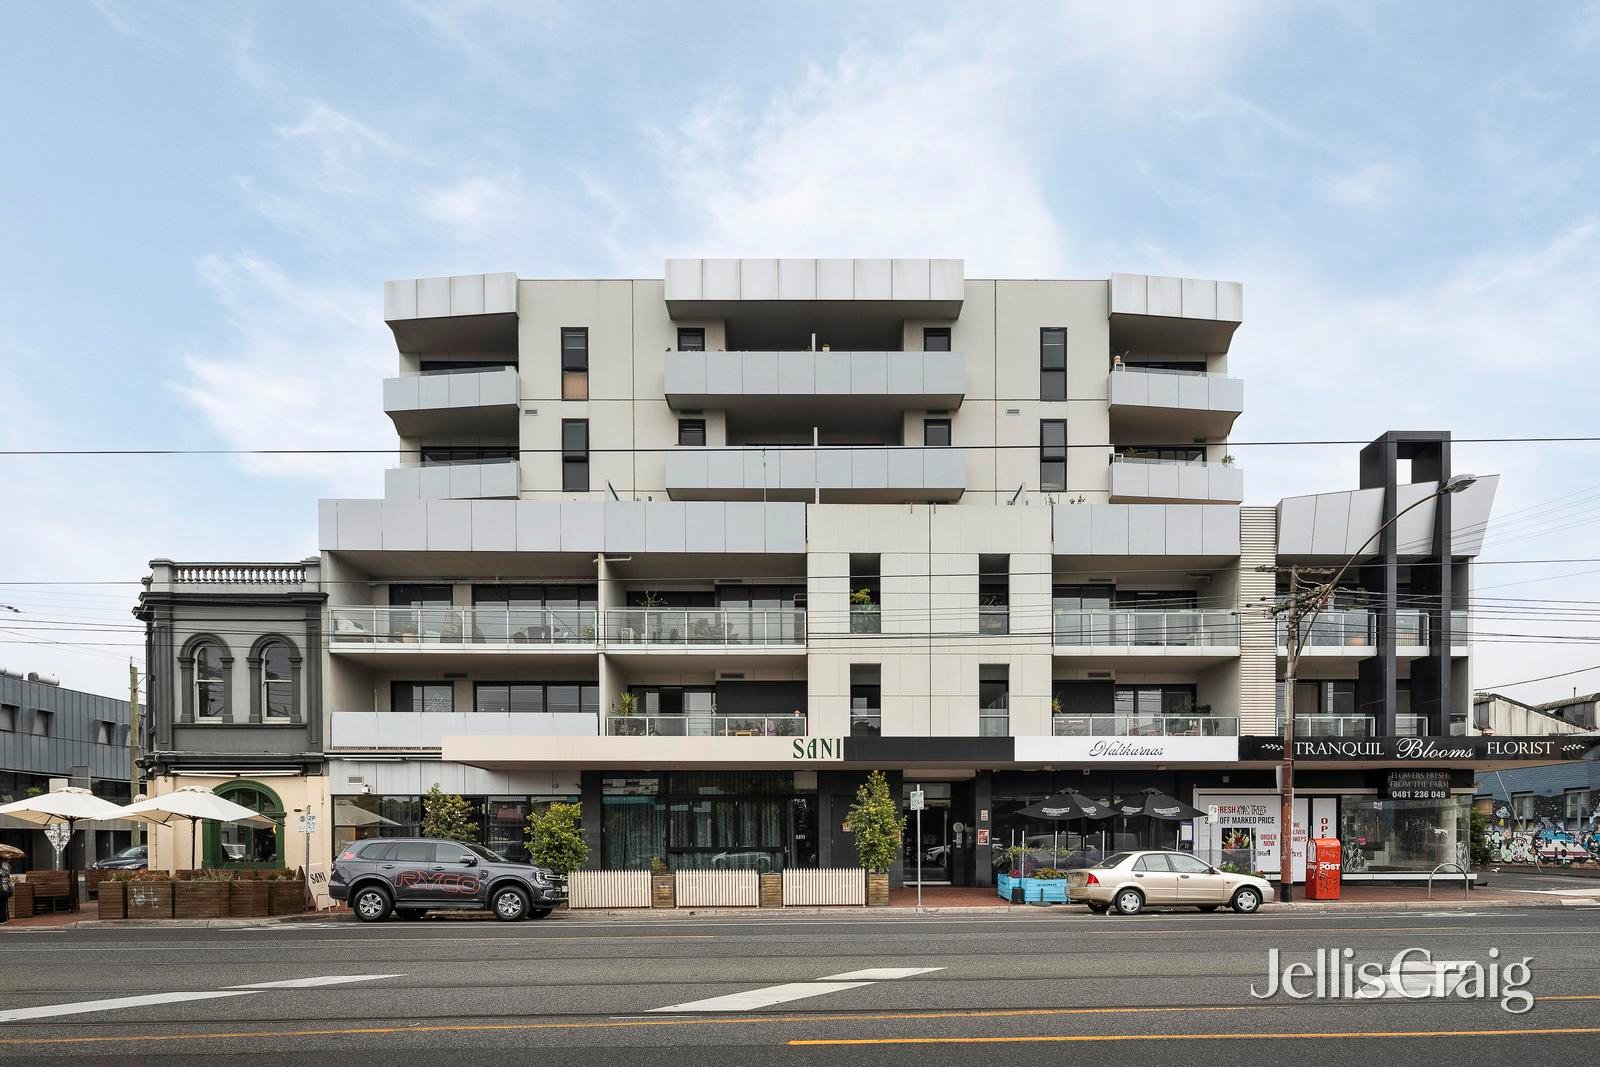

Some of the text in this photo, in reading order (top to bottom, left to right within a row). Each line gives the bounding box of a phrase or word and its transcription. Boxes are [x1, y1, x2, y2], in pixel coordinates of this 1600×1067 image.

[793, 738, 841, 759] SANI
[1294, 737, 1555, 759] TRANQUIL Blooms FLORIST
[1390, 780, 1449, 788] FROM THE FARM
[1392, 790, 1446, 798] 0481 236 049
[1219, 816, 1231, 824] OFF
[1231, 816, 1257, 825] MARKED
[1257, 816, 1275, 824] PRICE
[1260, 833, 1277, 841] ORDER
[1319, 863, 1341, 871] POST
[310, 872, 327, 884] SANI
[395, 869, 481, 895] RYCO
